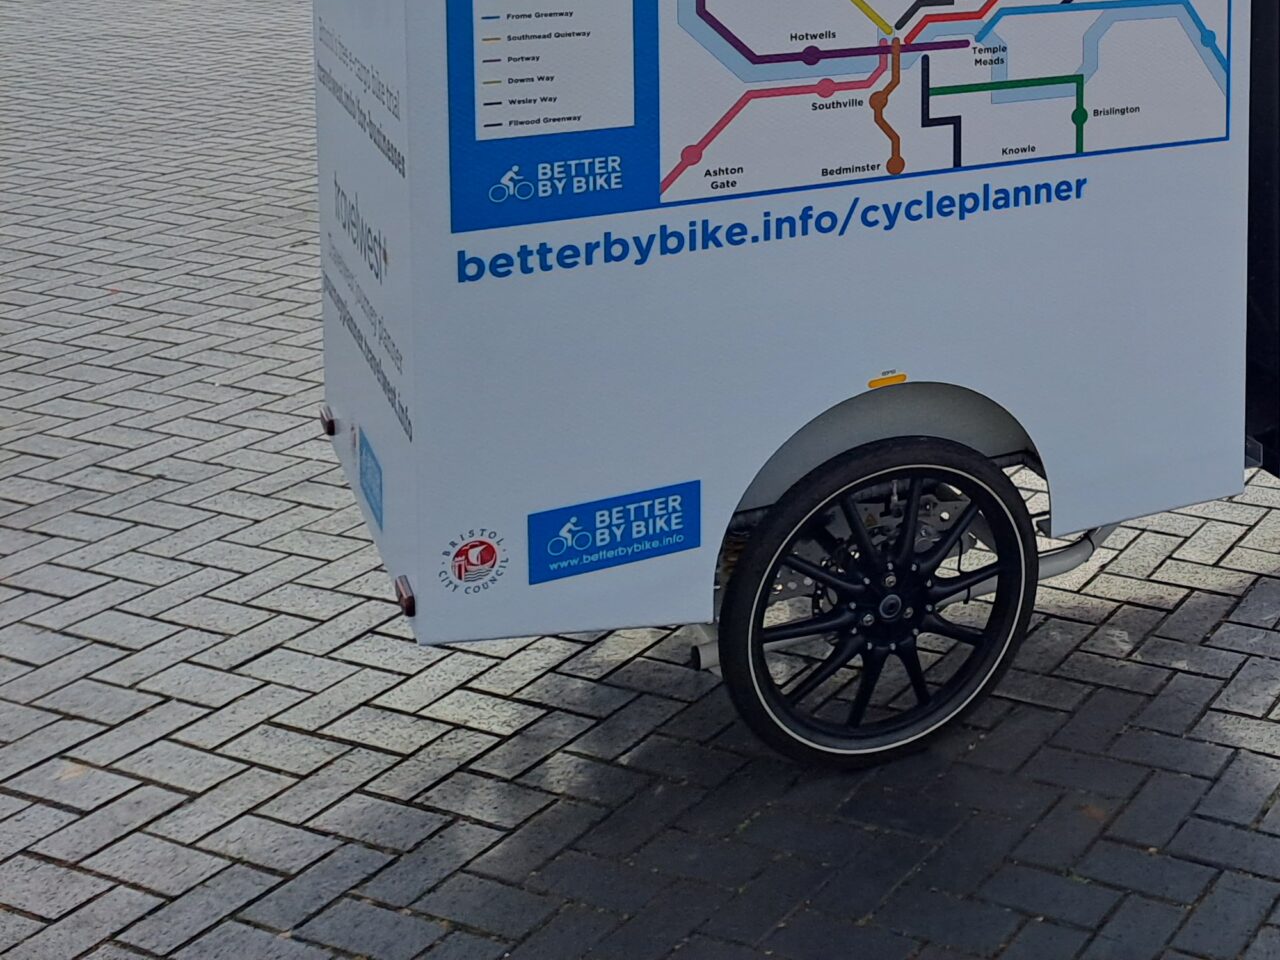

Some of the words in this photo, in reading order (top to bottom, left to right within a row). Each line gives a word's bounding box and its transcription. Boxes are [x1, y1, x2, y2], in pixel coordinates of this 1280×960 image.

[534, 10, 574, 19] Greenway
[507, 33, 552, 42] Southmead
[554, 30, 591, 39] Quietway
[790, 30, 836, 42] Hotwells
[972, 44, 1007, 56] Temple
[507, 54, 540, 63] Portway
[974, 57, 1005, 67] Meads
[507, 76, 535, 84] Downs
[537, 74, 555, 83] Way
[508, 98, 538, 107] Wesley
[539, 95, 557, 104] Way
[811, 98, 864, 111] Southville
[1093, 104, 1140, 117] Brislington
[508, 117, 541, 127] Filwood
[542, 115, 581, 125] Greenway
[1001, 144, 1036, 156] Knowle
[537, 155, 621, 180] BETTER
[704, 165, 744, 178] Ashton
[821, 162, 881, 177] Bedminster
[537, 179, 568, 198] BY
[573, 172, 623, 194] BIKE
[710, 179, 737, 190] Gate
[457, 176, 1089, 283] betterbybike.info/cycleplanner
[595, 494, 682, 529] BETTER
[595, 527, 625, 547] BY
[632, 512, 684, 539] BIKE
[442, 528, 504, 558] BRISTOL
[549, 532, 685, 571] www.betterbybike.info
[438, 570, 459, 594] CITY
[464, 556, 509, 596] COUNCIL
